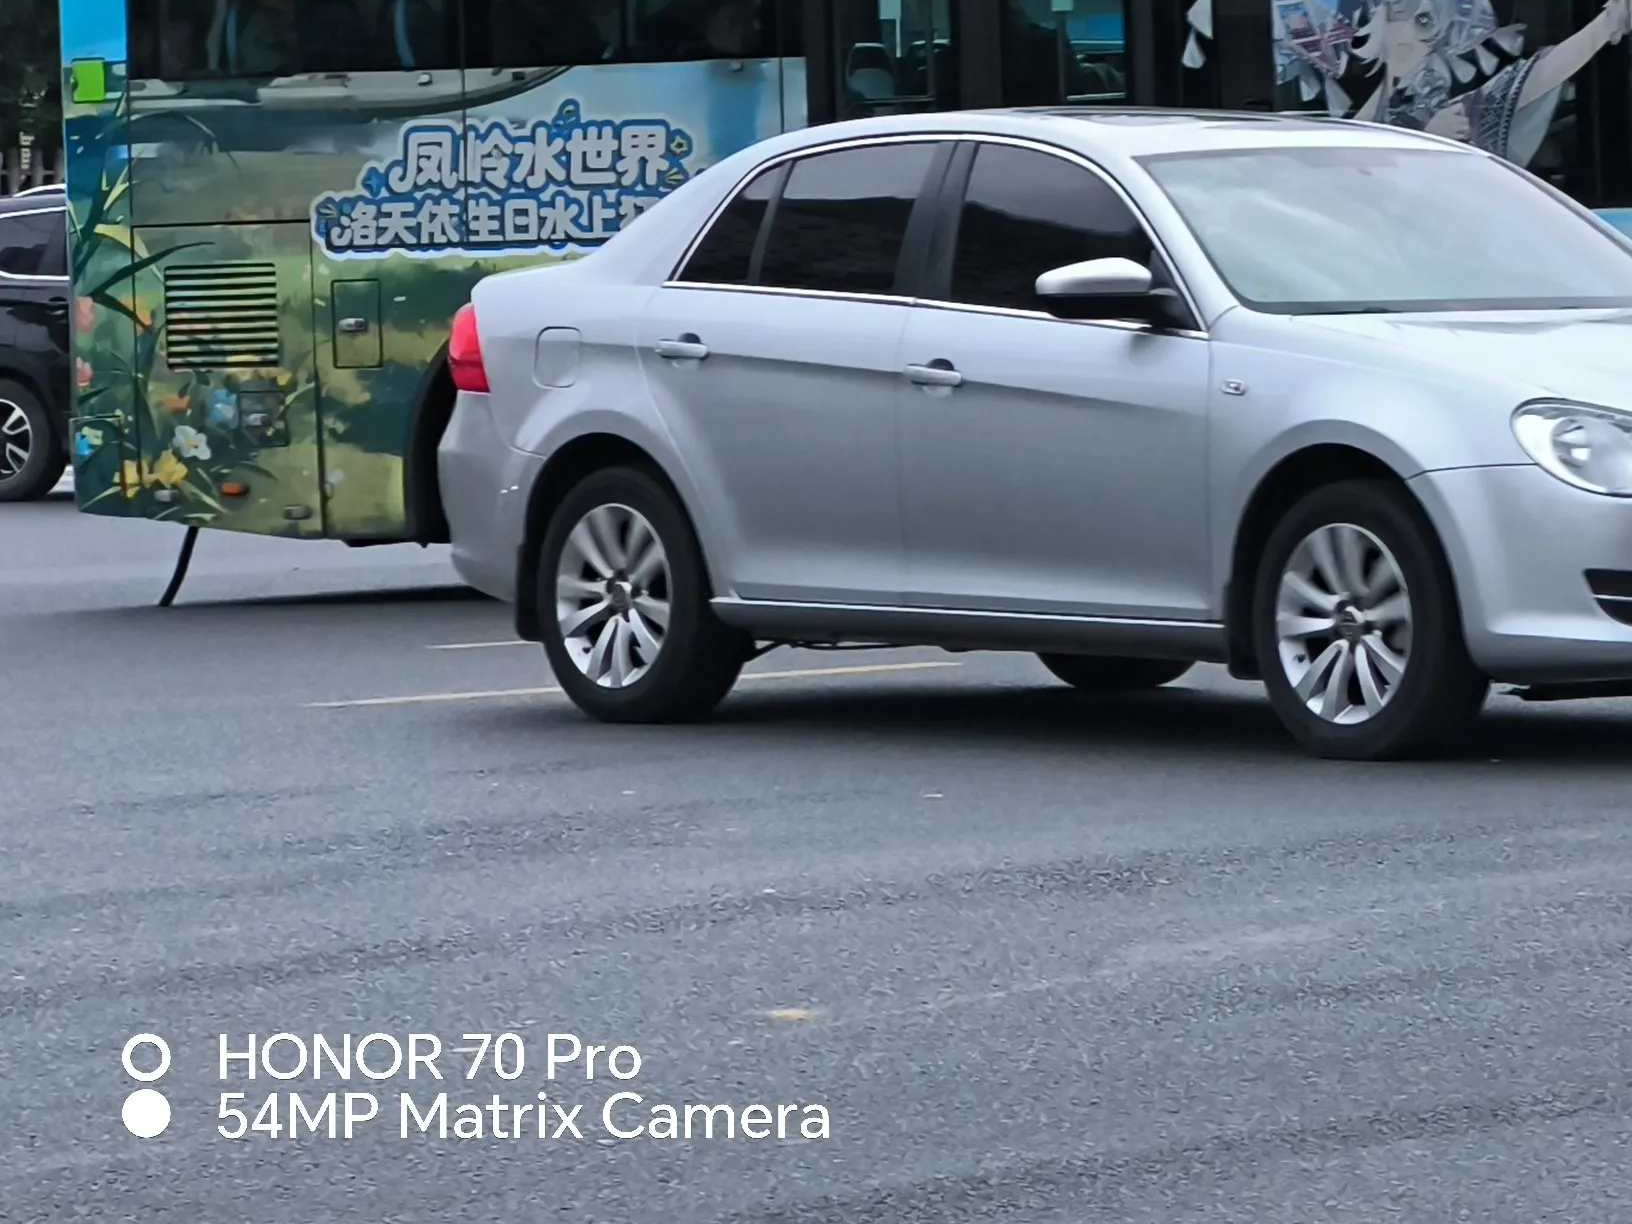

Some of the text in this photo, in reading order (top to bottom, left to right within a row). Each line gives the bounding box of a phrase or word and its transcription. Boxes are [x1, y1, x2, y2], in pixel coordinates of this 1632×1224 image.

[389, 126, 669, 192] 凤岭水世界
